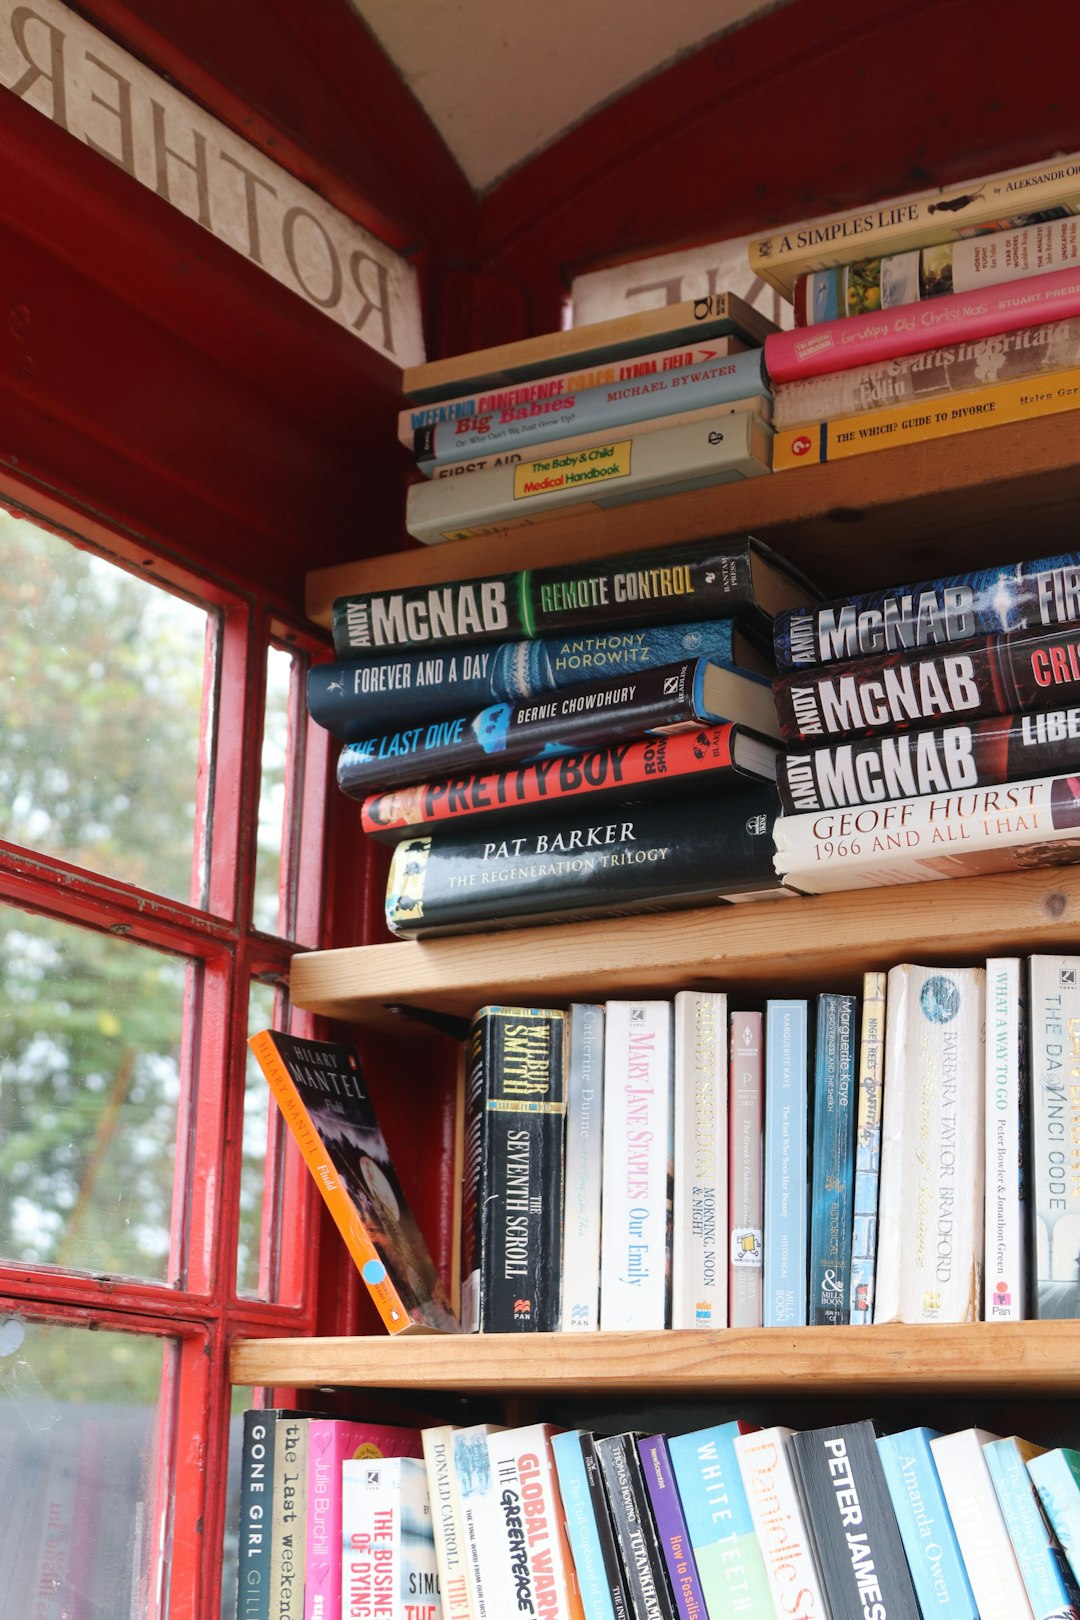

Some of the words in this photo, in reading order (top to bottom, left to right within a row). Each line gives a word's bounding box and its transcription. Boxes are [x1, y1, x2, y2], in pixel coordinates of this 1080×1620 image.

[779, 236, 793, 254] A
[796, 217, 873, 249] SIMPLES
[878, 203, 919, 229] LIFE
[998, 293, 1042, 309] STUART
[411, 399, 475, 431] WEEKEND
[478, 379, 565, 414] CONFIDENCE
[566, 367, 615, 394] COACH
[619, 360, 658, 382] LYNDA
[662, 352, 694, 371] FIELD
[606, 382, 668, 402] MICHAEL
[671, 364, 737, 388] BYWATER
[454, 415, 493, 435] Big
[499, 395, 577, 425] Babies
[836, 431, 856, 445] THE
[859, 422, 899, 440] WHICH?
[902, 414, 932, 431] GUIDE
[935, 409, 948, 423] TO
[951, 401, 996, 419] DIVORCE
[523, 475, 564, 494] Medical
[565, 463, 620, 486] Handbook
[532, 461, 550, 474] The
[552, 455, 577, 471] Baby
[579, 453, 588, 463] &
[588, 446, 615, 462] Child
[541, 576, 610, 613] REMOTE
[613, 565, 695, 603] CONTROL
[730, 560, 738, 587] PRESS
[347, 603, 371, 648] ANDY
[371, 581, 510, 647] McNAB
[818, 585, 977, 662] McNAB
[555, 646, 650, 671] HOROWITZ
[560, 633, 647, 655] ANTHONY
[790, 614, 816, 663] ANDY
[354, 663, 411, 694] FOREVER
[416, 659, 444, 687] AND
[448, 656, 458, 682] A
[463, 653, 489, 680] DAY
[678, 664, 688, 703] HEADLINE
[817, 655, 982, 734] McNAB
[517, 702, 558, 724] BERNIE
[561, 685, 637, 714] CHOWDHURY
[791, 686, 823, 735] ANDY
[345, 738, 378, 768] THE
[378, 728, 423, 760] LAST
[424, 717, 466, 748] DIVE
[713, 729, 721, 757] BLAKE
[1022, 708, 1080, 747] LIBE
[786, 755, 820, 809] ANDY
[815, 726, 979, 809] McNAB
[812, 801, 915, 841] GEOFF
[928, 784, 1043, 823] HURST
[483, 838, 527, 862] PAT
[535, 822, 637, 854] BARKER
[815, 839, 861, 861] 1966
[872, 829, 920, 853] AND
[932, 822, 970, 844] ALL
[982, 812, 1040, 836] THAT
[448, 874, 478, 889] THE
[481, 858, 596, 885] REGENERATION
[601, 847, 669, 866] TRILOGY
[996, 972, 1008, 1008] WHAT
[828, 1013, 836, 1056] GOVERNESS
[838, 1000, 853, 1069] Marguerite
[996, 1012, 1008, 1024] A
[1045, 994, 1062, 1034] THE
[293, 1045, 338, 1069] HILARY
[503, 1023, 529, 1095] SMITH
[527, 1023, 549, 1096] WILBUR
[582, 1011, 595, 1082] Catherine
[628, 1031, 655, 1088] MARY
[783, 1013, 791, 1068] MARGUERITE
[996, 1027, 1008, 1062] WAY
[1046, 1044, 1063, 1071] DA
[288, 1061, 366, 1099] MANTEL
[782, 1069, 790, 1089] KAYE
[838, 1073, 852, 1107] Kaye
[942, 1031, 958, 1108] BARBARA
[996, 1065, 1008, 1086] TO
[258, 1042, 289, 1093] HILARY
[284, 1098, 320, 1156] MANTEL
[581, 1088, 594, 1138] Dunne
[624, 1084, 655, 1128] JANE
[996, 1088, 1008, 1111] GO
[1043, 1075, 1067, 1141] VINCI
[939, 1113, 957, 1179] TAYLOR
[998, 1119, 1007, 1141] Peter
[316, 1164, 338, 1192] Fludd
[505, 1130, 530, 1213] SEVENTH
[626, 1130, 654, 1201] STAPLES
[998, 1143, 1007, 1184] Bowler
[1048, 1152, 1066, 1210] CODE
[530, 1195, 542, 1215] THE
[692, 1186, 703, 1198] &
[998, 1185, 1006, 1193] &
[628, 1207, 649, 1239] Our
[692, 1200, 703, 1237] NIGHT
[702, 1187, 715, 1249] MORNING,
[936, 1186, 955, 1283] BRADFORD
[998, 1194, 1007, 1242] Jonathon
[504, 1215, 530, 1280] SCROLL
[618, 1243, 649, 1288] Emily
[703, 1250, 716, 1287] NOON
[998, 1243, 1006, 1274] Green
[513, 1312, 531, 1320] PAN
[570, 1319, 589, 1327] PAN
[776, 1289, 785, 1321] BOON
[992, 1306, 1011, 1316] Pan
[250, 1425, 266, 1492] GONE
[286, 1424, 300, 1463] the
[315, 1458, 330, 1494] Julie
[434, 1443, 451, 1502] DONALD
[497, 1456, 518, 1486] THE
[612, 1446, 626, 1484] THOMAS
[620, 1485, 636, 1522] HOVING
[1007, 1463, 1020, 1489] The
[283, 1473, 299, 1523] last
[517, 1453, 549, 1546] GLOBAL
[744, 1442, 803, 1582] Danielle
[248, 1505, 263, 1558] GIRL
[313, 1498, 330, 1555] Burchill
[351, 1533, 371, 1555] OF
[442, 1504, 460, 1570] CARROLL
[670, 1535, 684, 1560] How
[697, 1441, 733, 1524] WHITE
[718, 1531, 753, 1612] TEETH
[824, 1437, 863, 1527] PETER
[845, 1532, 887, 1620] JAMES
[898, 1455, 934, 1539] Amanda
[925, 1543, 951, 1606] Owen
[500, 1489, 535, 1616] GREENPEACE
[676, 1561, 687, 1575] to
[351, 1562, 371, 1618] DYING
[447, 1574, 468, 1610] THE
[471, 1544, 479, 1563] WORD
[479, 1599, 487, 1618] FIRST
